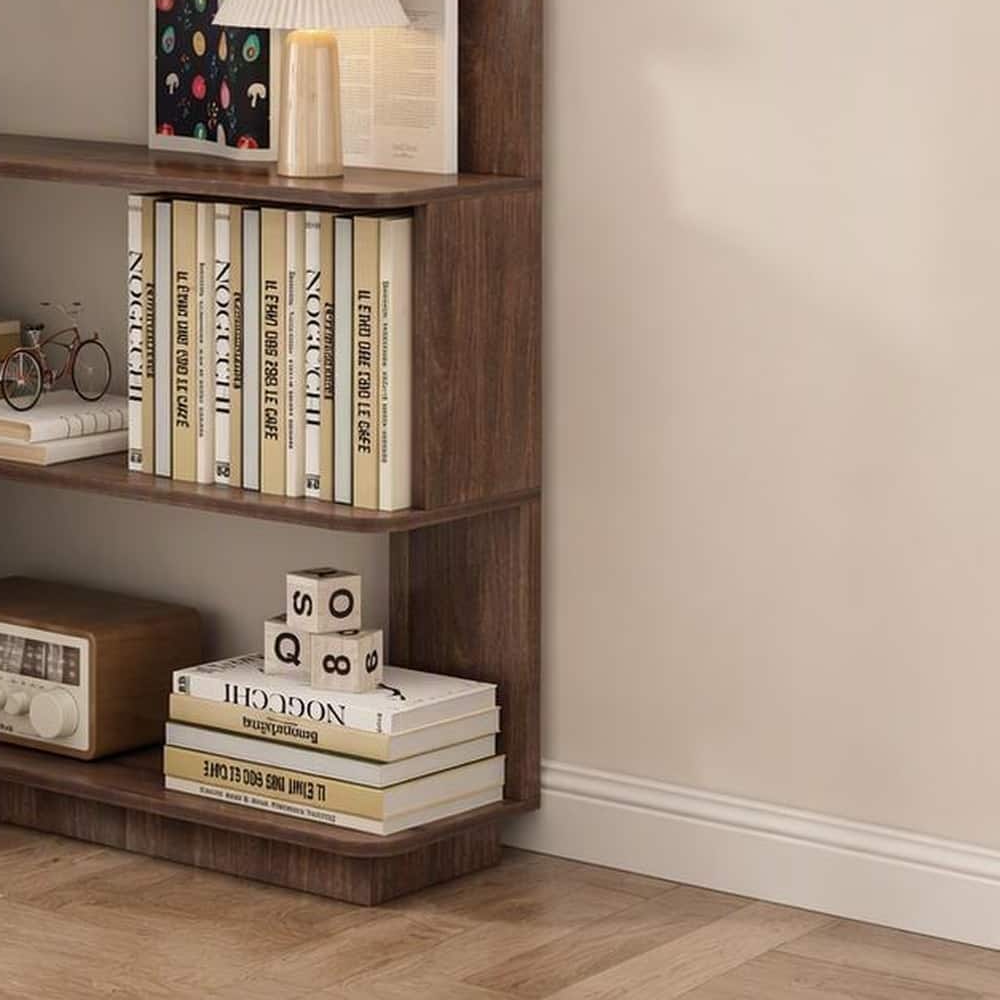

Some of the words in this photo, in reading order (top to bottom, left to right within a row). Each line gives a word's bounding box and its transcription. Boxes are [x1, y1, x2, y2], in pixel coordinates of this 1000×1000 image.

[274, 632, 302, 667] Q
[322, 654, 351, 676] 8
[223, 683, 346, 726] NOGUCHI
